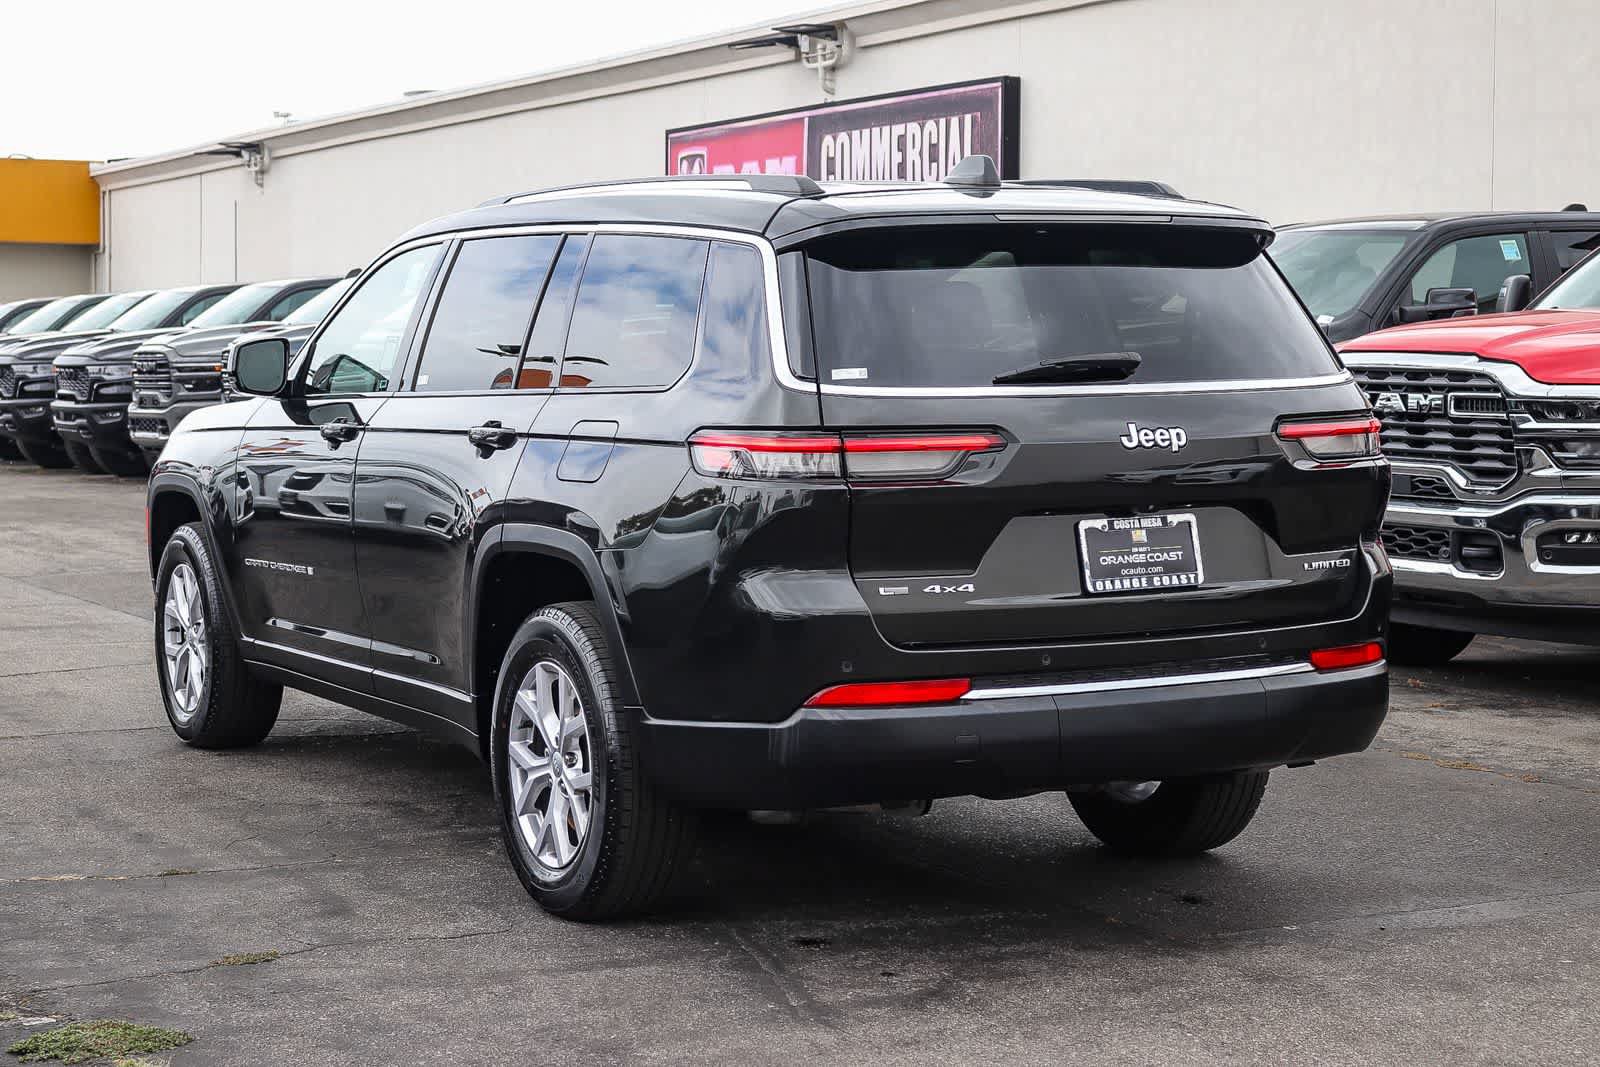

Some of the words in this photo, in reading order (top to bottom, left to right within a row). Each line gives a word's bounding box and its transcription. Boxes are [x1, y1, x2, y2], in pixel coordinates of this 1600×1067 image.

[1120, 422, 1187, 453] Jeep
[1113, 518, 1140, 530] COSTA
[1099, 554, 1146, 565] ORANGE
[1147, 551, 1183, 562] COAST
[1303, 558, 1350, 571] LIMITED
[1120, 566, 1164, 576] ocauto.com
[1095, 577, 1148, 591] ORANGE
[1153, 573, 1196, 586] COAST
